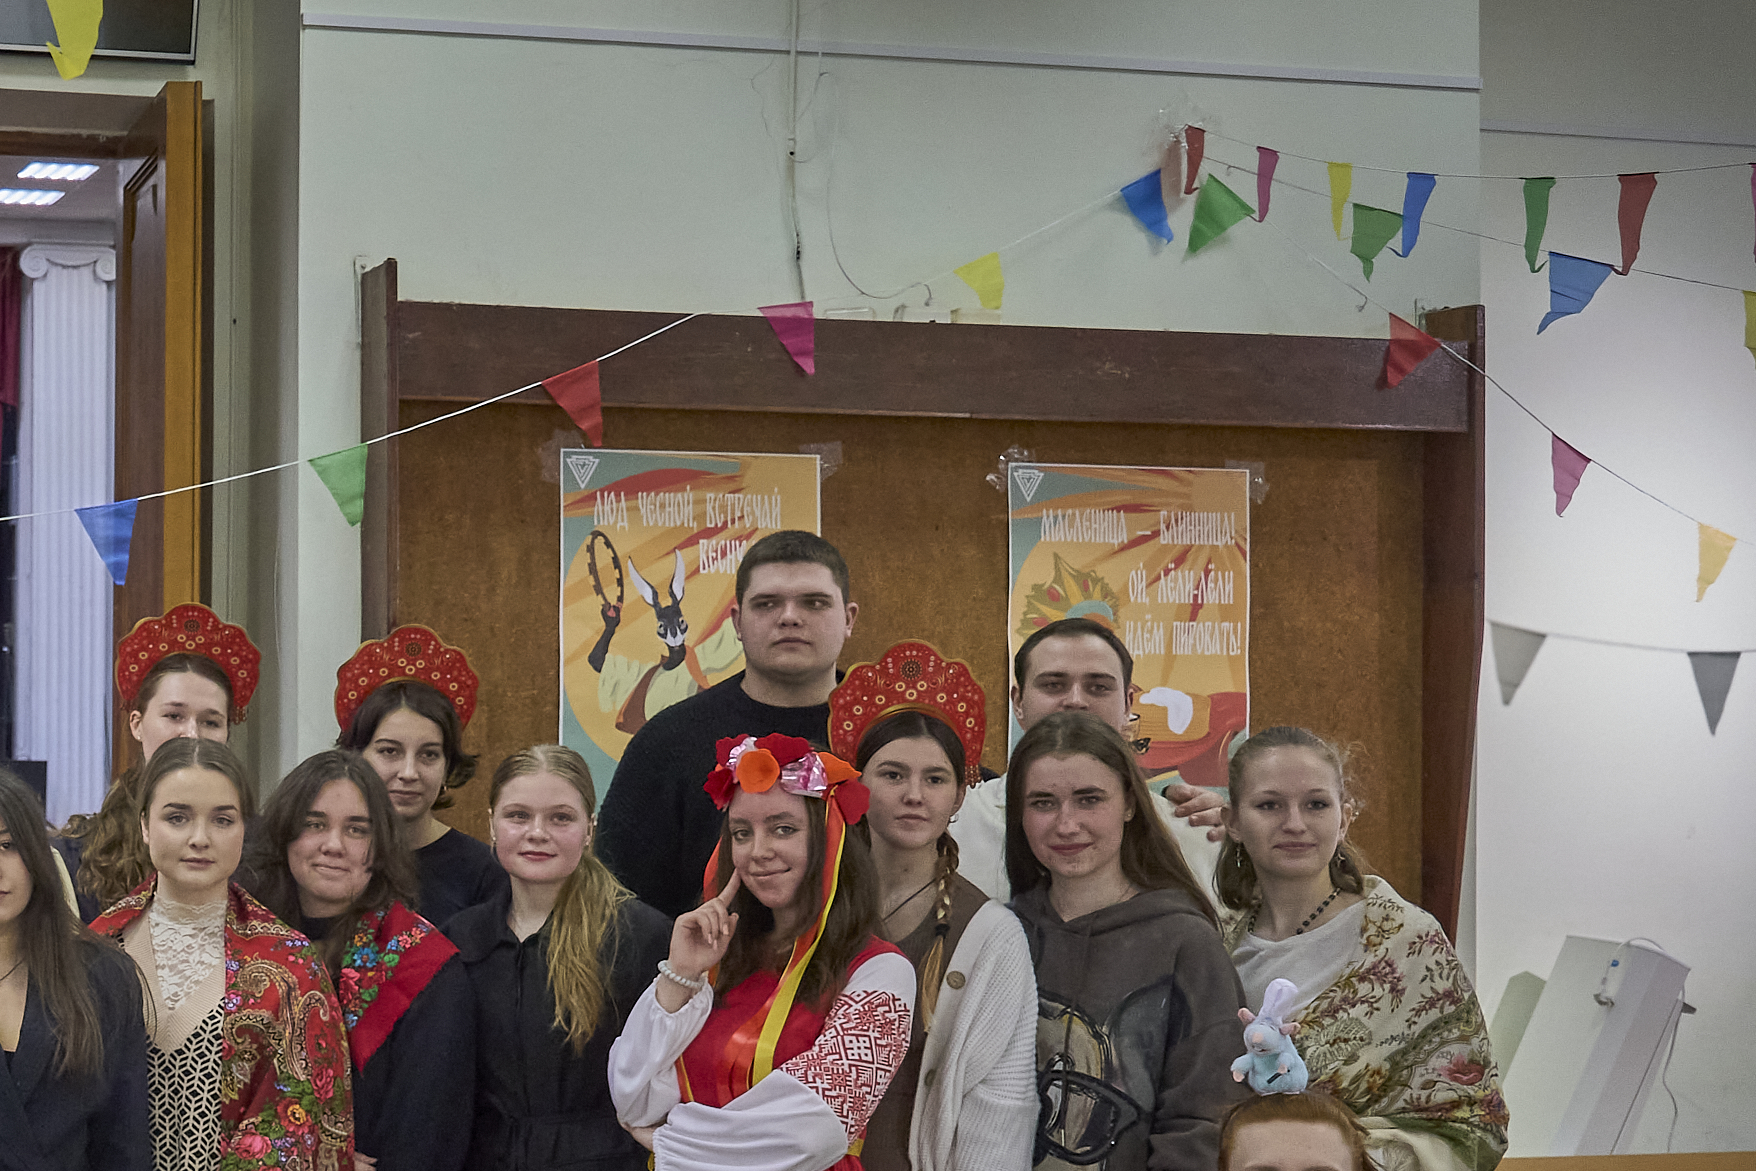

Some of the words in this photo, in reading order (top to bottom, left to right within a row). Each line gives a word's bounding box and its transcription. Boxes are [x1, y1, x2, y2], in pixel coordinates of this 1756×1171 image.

[593, 490, 628, 533] ЛЮД
[706, 487, 782, 529] ВСТРЕЧАЙ
[1041, 508, 1128, 547] МАСЛЕНИЦА
[1159, 510, 1236, 547] БЛИННИЦА!
[1157, 563, 1234, 605] ЛЁЛИ-ЛЁЛИ
[1125, 615, 1165, 659] ИДЁМ
[1172, 621, 1242, 656] ПИРОВАТЬ!
